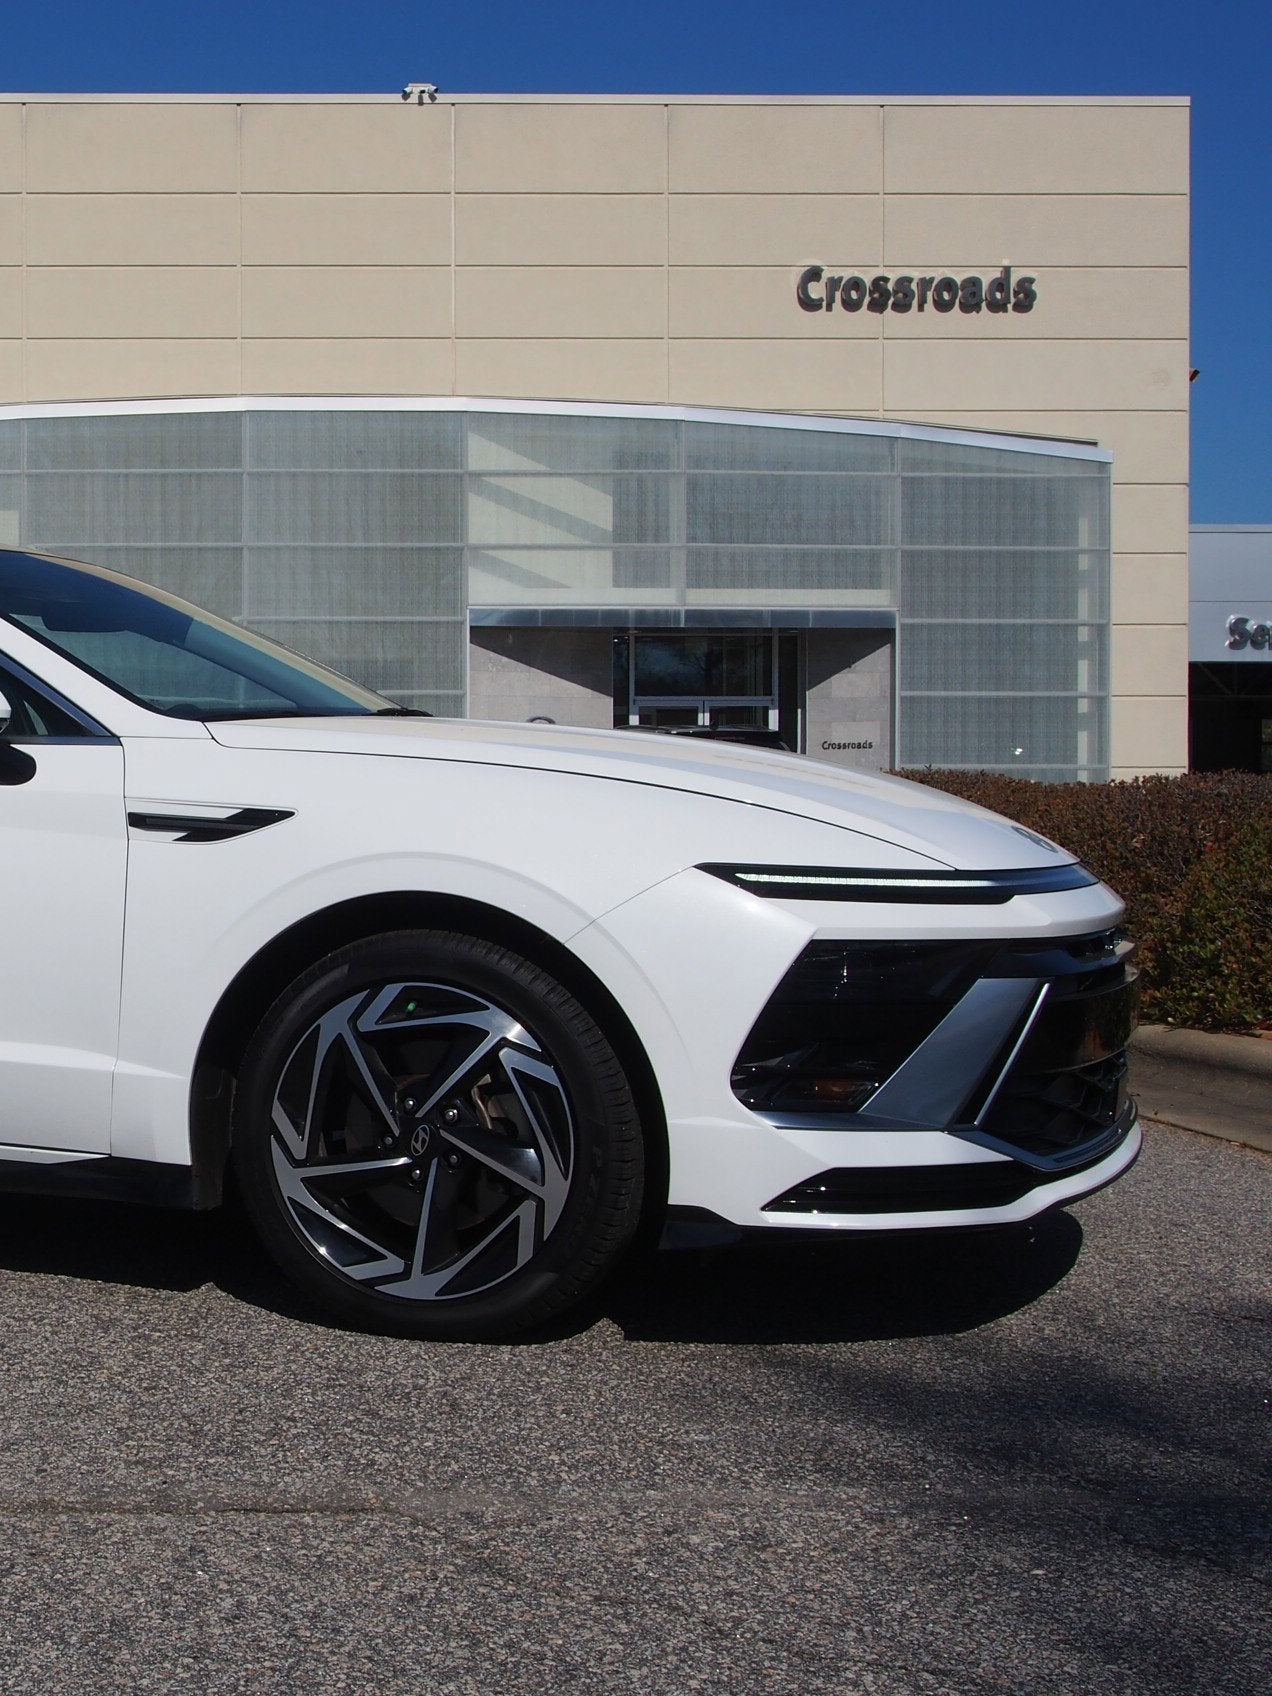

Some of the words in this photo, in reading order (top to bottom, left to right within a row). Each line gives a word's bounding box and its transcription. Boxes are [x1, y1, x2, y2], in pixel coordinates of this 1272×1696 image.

[796, 264, 1038, 314] Crossroads
[1227, 616, 1272, 651] Se
[821, 740, 873, 750] Crossroads
